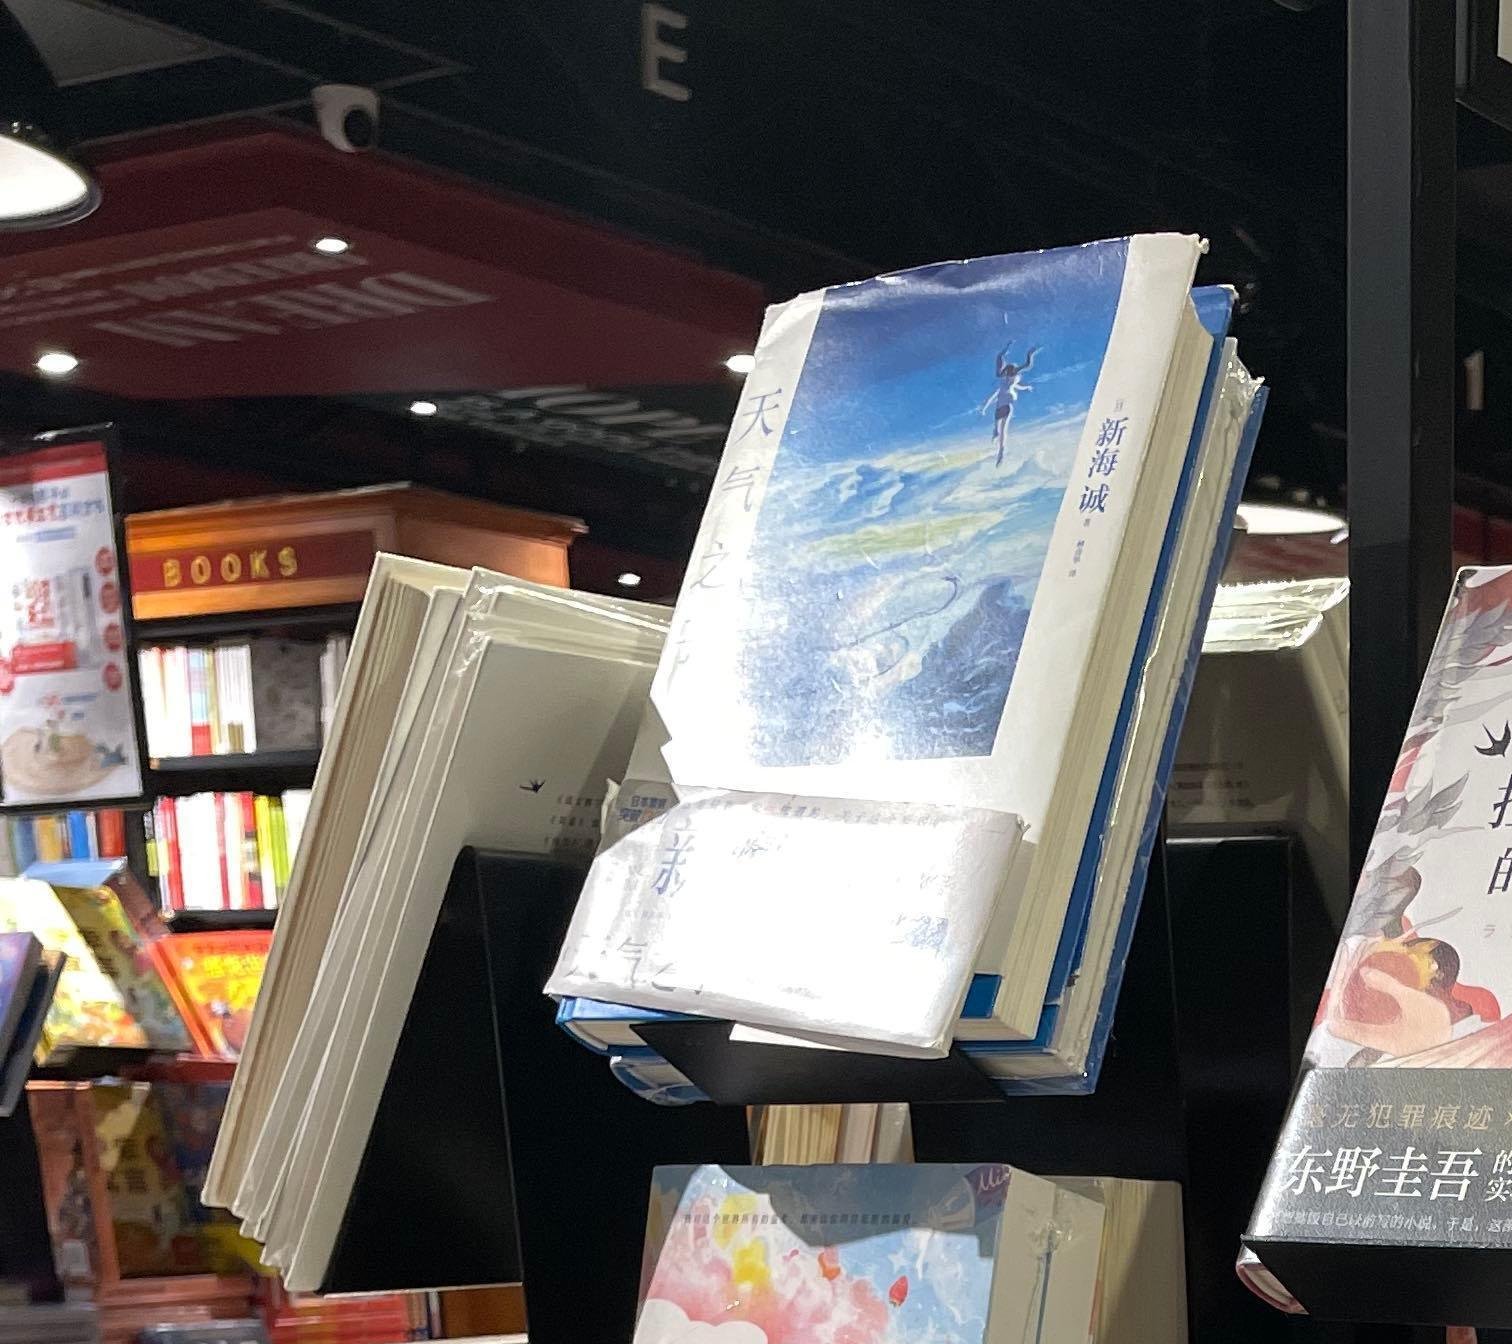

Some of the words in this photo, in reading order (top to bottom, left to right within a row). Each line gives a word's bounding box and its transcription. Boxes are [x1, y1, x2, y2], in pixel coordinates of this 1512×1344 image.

[643, 3, 692, 102] E
[1078, 416, 1129, 513] 新海诚
[161, 546, 299, 588] BOOKS
[1281, 1146, 1483, 1202] 东野圭吾
